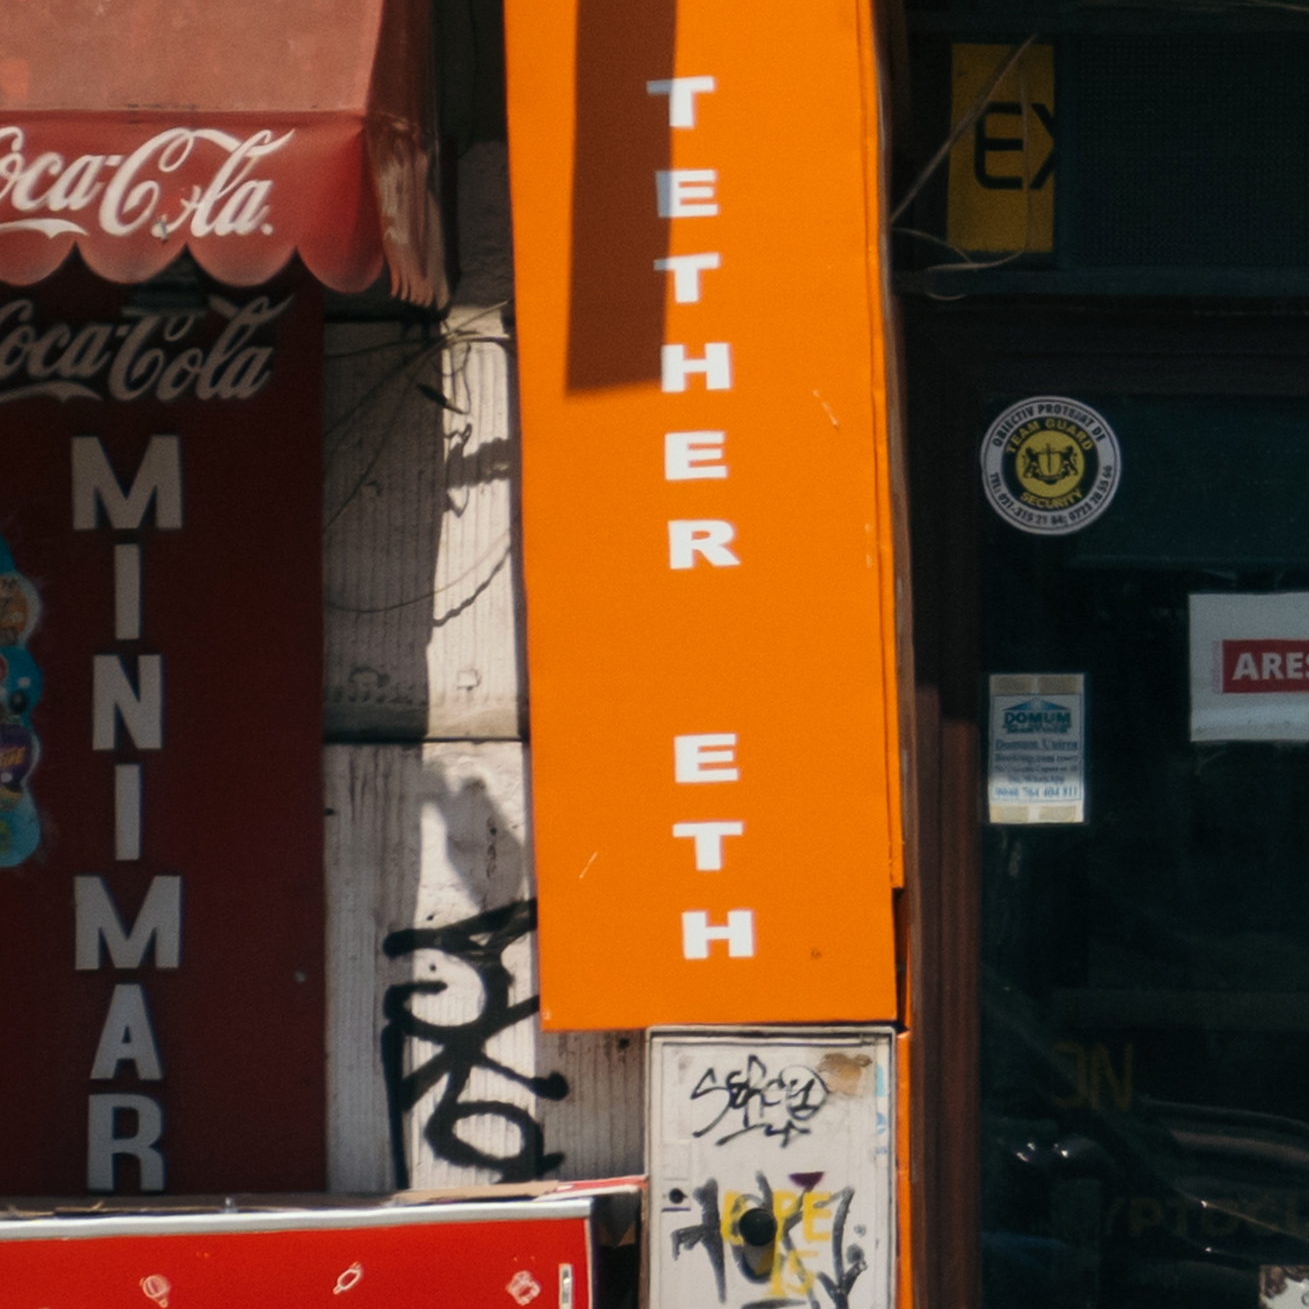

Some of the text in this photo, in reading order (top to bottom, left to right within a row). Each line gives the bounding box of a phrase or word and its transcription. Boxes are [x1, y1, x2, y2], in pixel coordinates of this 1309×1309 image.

[646, 76, 741, 570] TETHER
[1006, 418, 1094, 454] TEAM GUARD
[1020, 488, 1083, 509] SECURITY
[673, 733, 756, 959] ETH
